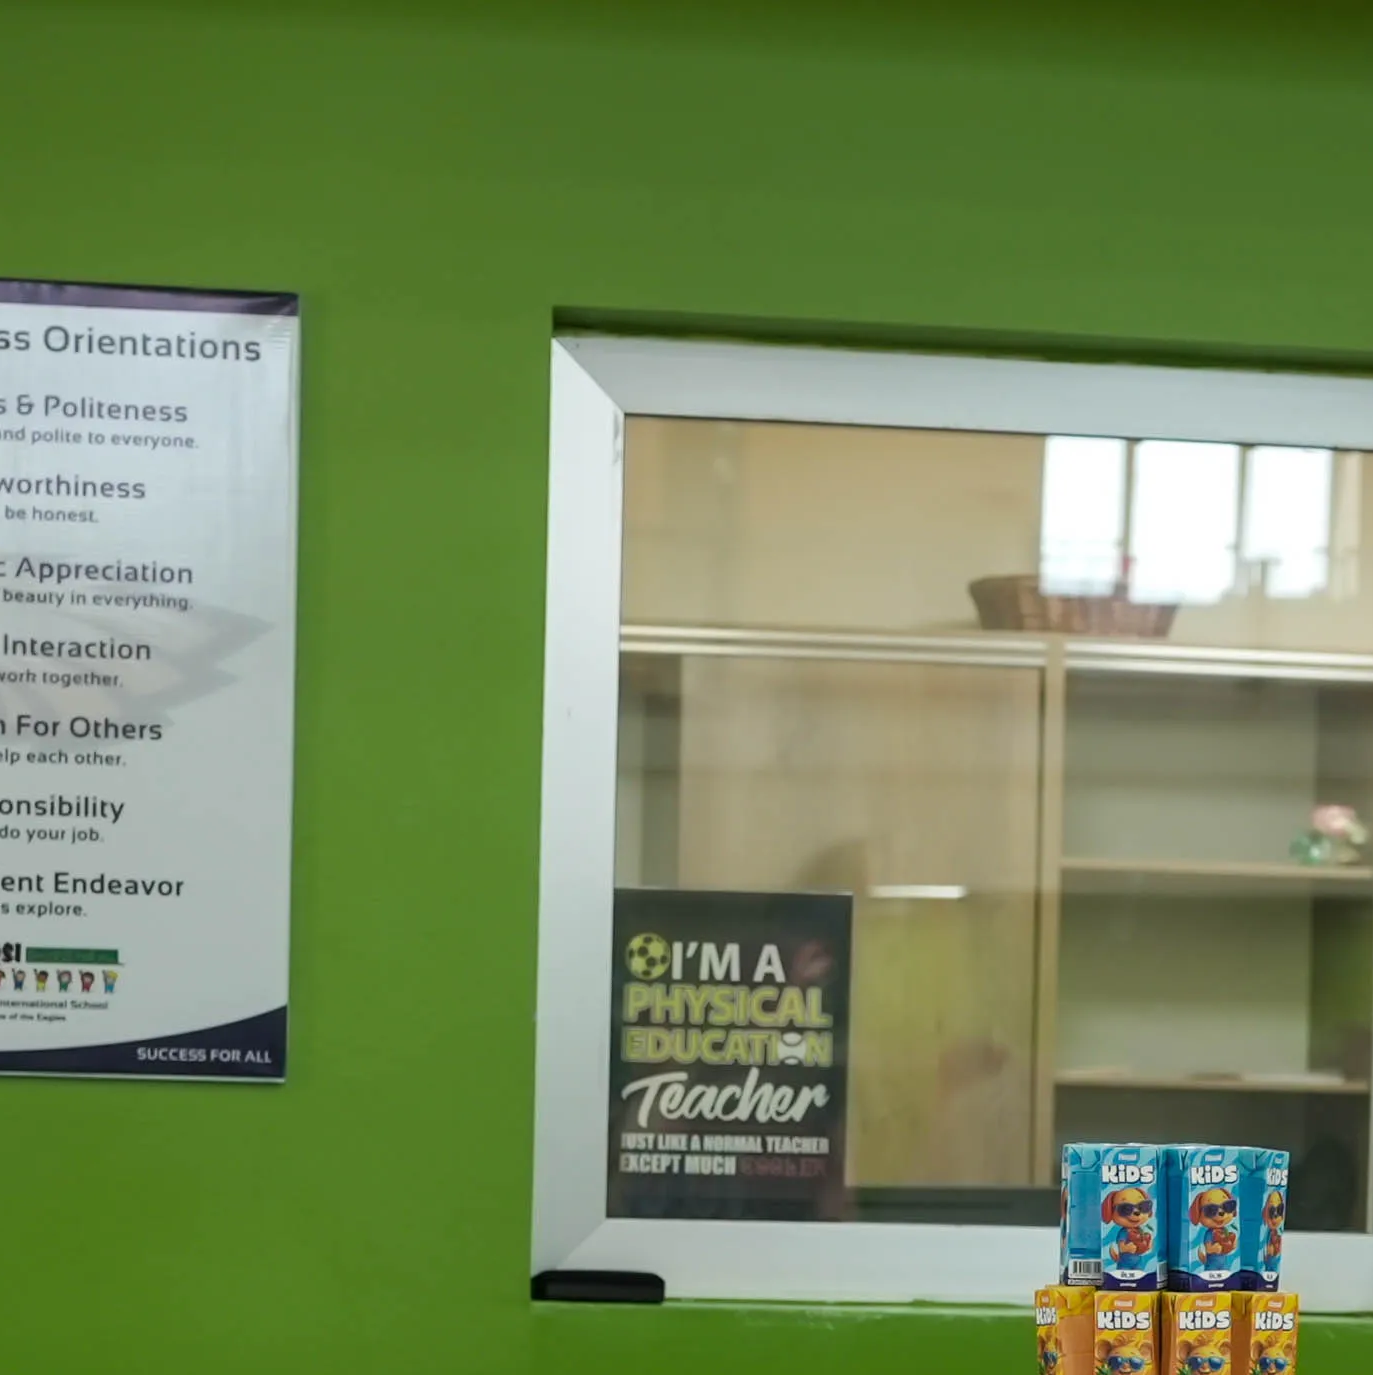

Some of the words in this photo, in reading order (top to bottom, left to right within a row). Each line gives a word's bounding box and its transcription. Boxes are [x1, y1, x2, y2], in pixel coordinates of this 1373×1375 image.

[44, 325, 261, 361] Orientations
[16, 394, 34, 415] &
[44, 395, 188, 422] Politeness
[31, 429, 82, 445] polite
[88, 431, 105, 445] to
[111, 434, 199, 450] everyone.
[5, 503, 27, 520] be
[32, 505, 99, 523] honest.
[15, 556, 194, 584] Appreciation
[2, 586, 65, 607] beauty
[70, 590, 86, 605] in
[92, 591, 193, 611] everything.
[3, 634, 151, 660] Interaction
[42, 670, 123, 688] together.
[16, 714, 60, 737] For
[70, 716, 163, 741] Others
[26, 751, 68, 765] each
[74, 752, 126, 767] other.
[26, 829, 66, 844] your
[71, 827, 104, 844] job.
[54, 872, 184, 897] Endeavor
[15, 901, 87, 918] explore.
[671, 941, 741, 983] I'M
[753, 943, 787, 984] A
[623, 982, 834, 1028] PHYSICAL
[136, 1046, 207, 1062] SUCCESS
[210, 1048, 242, 1063] FOR
[244, 1049, 272, 1064] ALL
[621, 1067, 830, 1128] Teacher
[621, 1132, 655, 1150] JUST
[658, 1133, 688, 1151] LIKE
[690, 1134, 702, 1151] A
[703, 1135, 763, 1153] NORMAL
[766, 1136, 830, 1154] TEACHER
[620, 1154, 682, 1174] EXCEPT
[684, 1155, 737, 1176] MUCH
